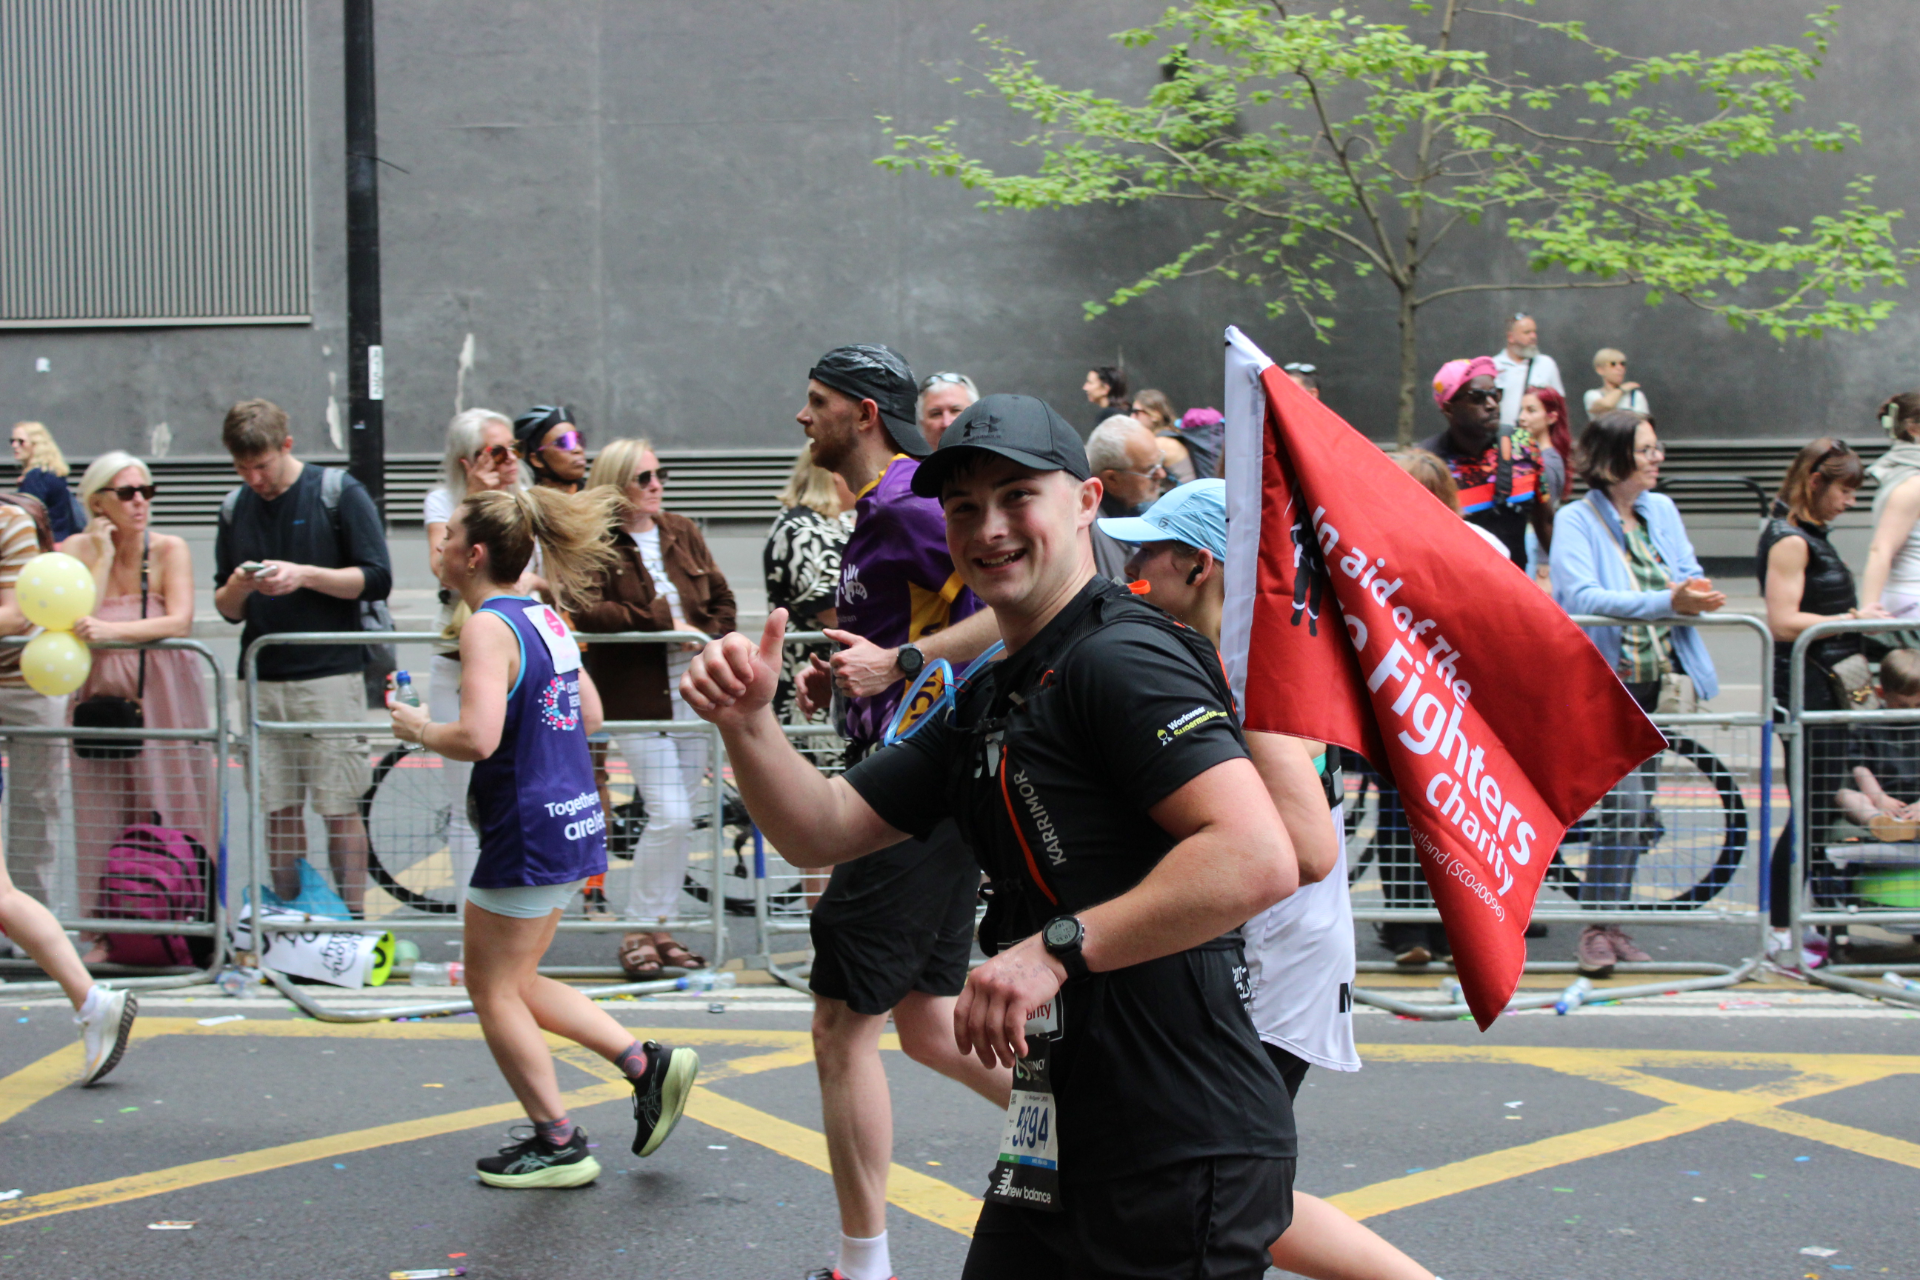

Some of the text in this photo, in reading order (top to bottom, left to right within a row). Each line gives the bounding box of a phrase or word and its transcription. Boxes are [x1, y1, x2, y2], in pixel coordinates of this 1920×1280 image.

[1312, 505, 1339, 556] In
[1340, 546, 1403, 608] aid
[1392, 605, 1437, 645] of
[1425, 634, 1472, 708] The
[1166, 705, 1206, 731] Workwear
[1367, 637, 1538, 866] Fighters
[1013, 768, 1067, 866] KARRIMOR
[1425, 772, 1514, 897] Charity
[1445, 858, 1506, 923] (SC040096)
[1026, 1002, 1052, 1021] arity
[1023, 1185, 1052, 1204] balance
